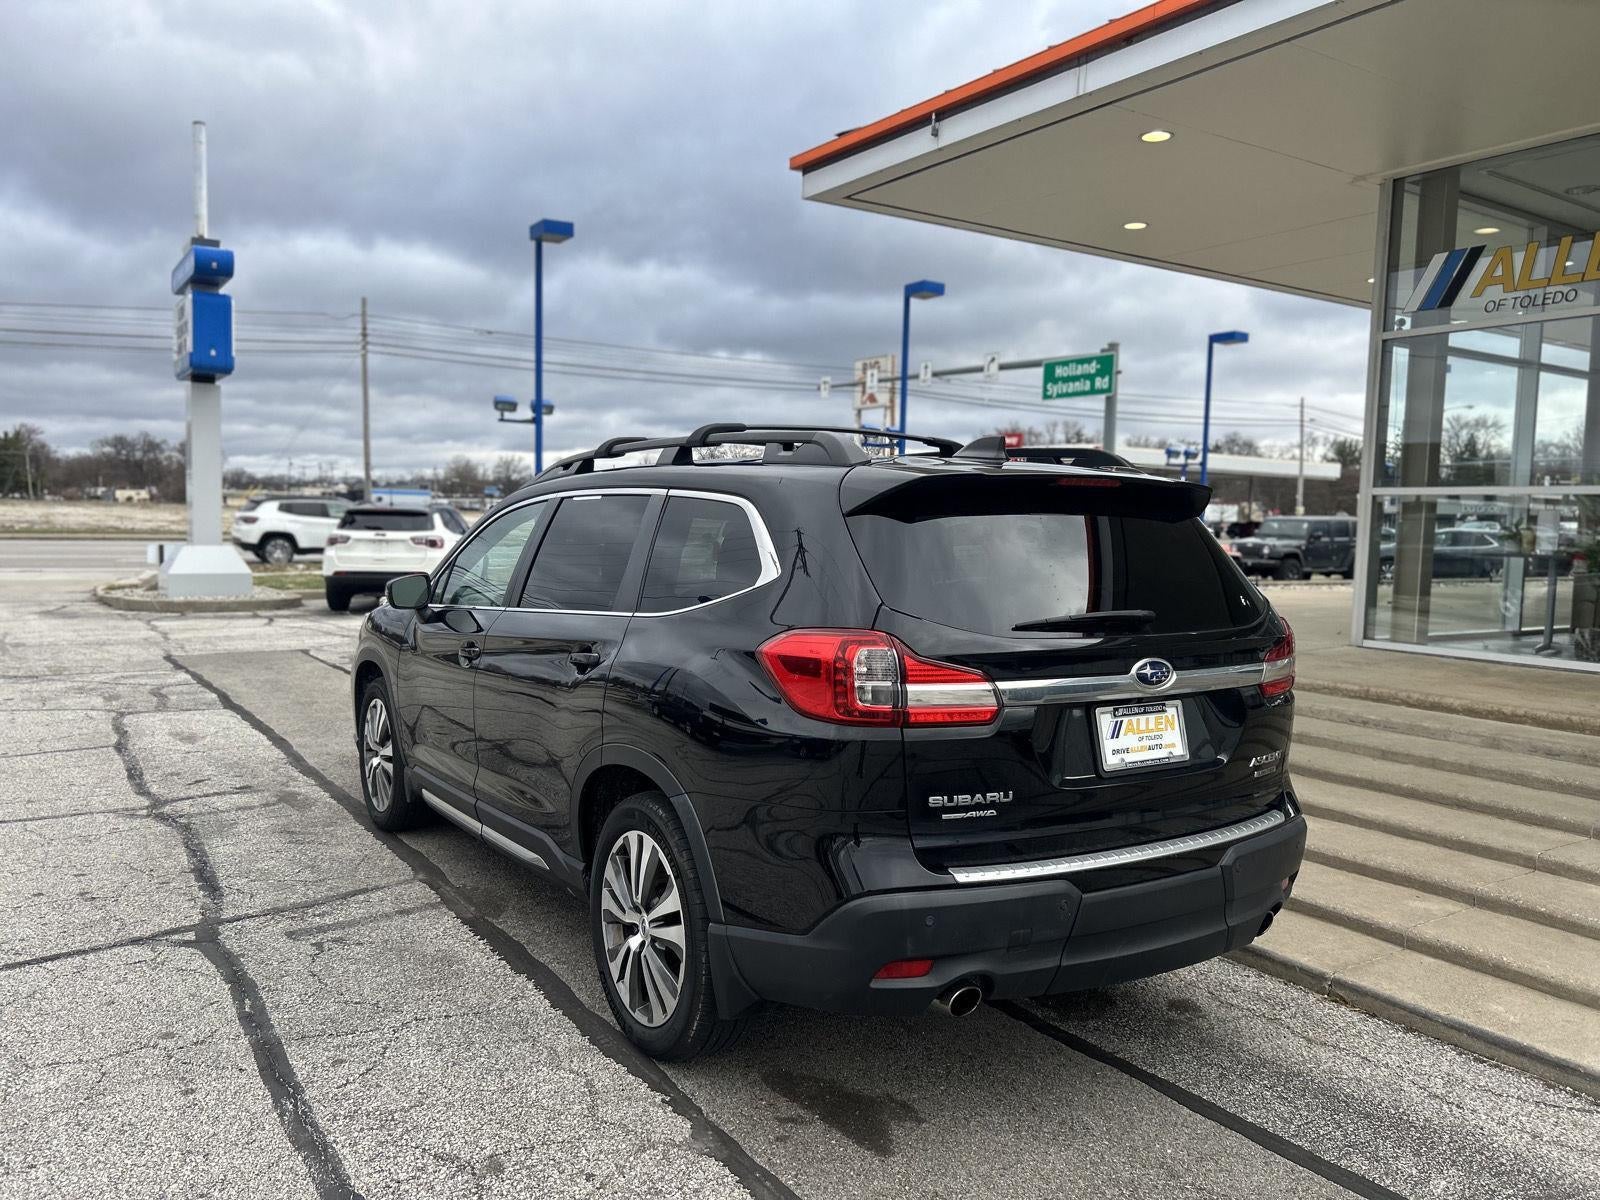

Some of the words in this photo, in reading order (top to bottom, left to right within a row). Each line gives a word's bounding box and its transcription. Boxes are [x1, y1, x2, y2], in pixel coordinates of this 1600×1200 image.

[1484, 299, 1507, 313] OF
[1512, 288, 1578, 309] TOLEDO
[1055, 360, 1101, 377] Holland-
[1046, 379, 1090, 399] Sylvania
[1095, 375, 1109, 390] Rd
[1123, 706, 1138, 715] ALLEN
[1124, 714, 1176, 736] ALLEN
[928, 791, 1013, 807] SUBARU
